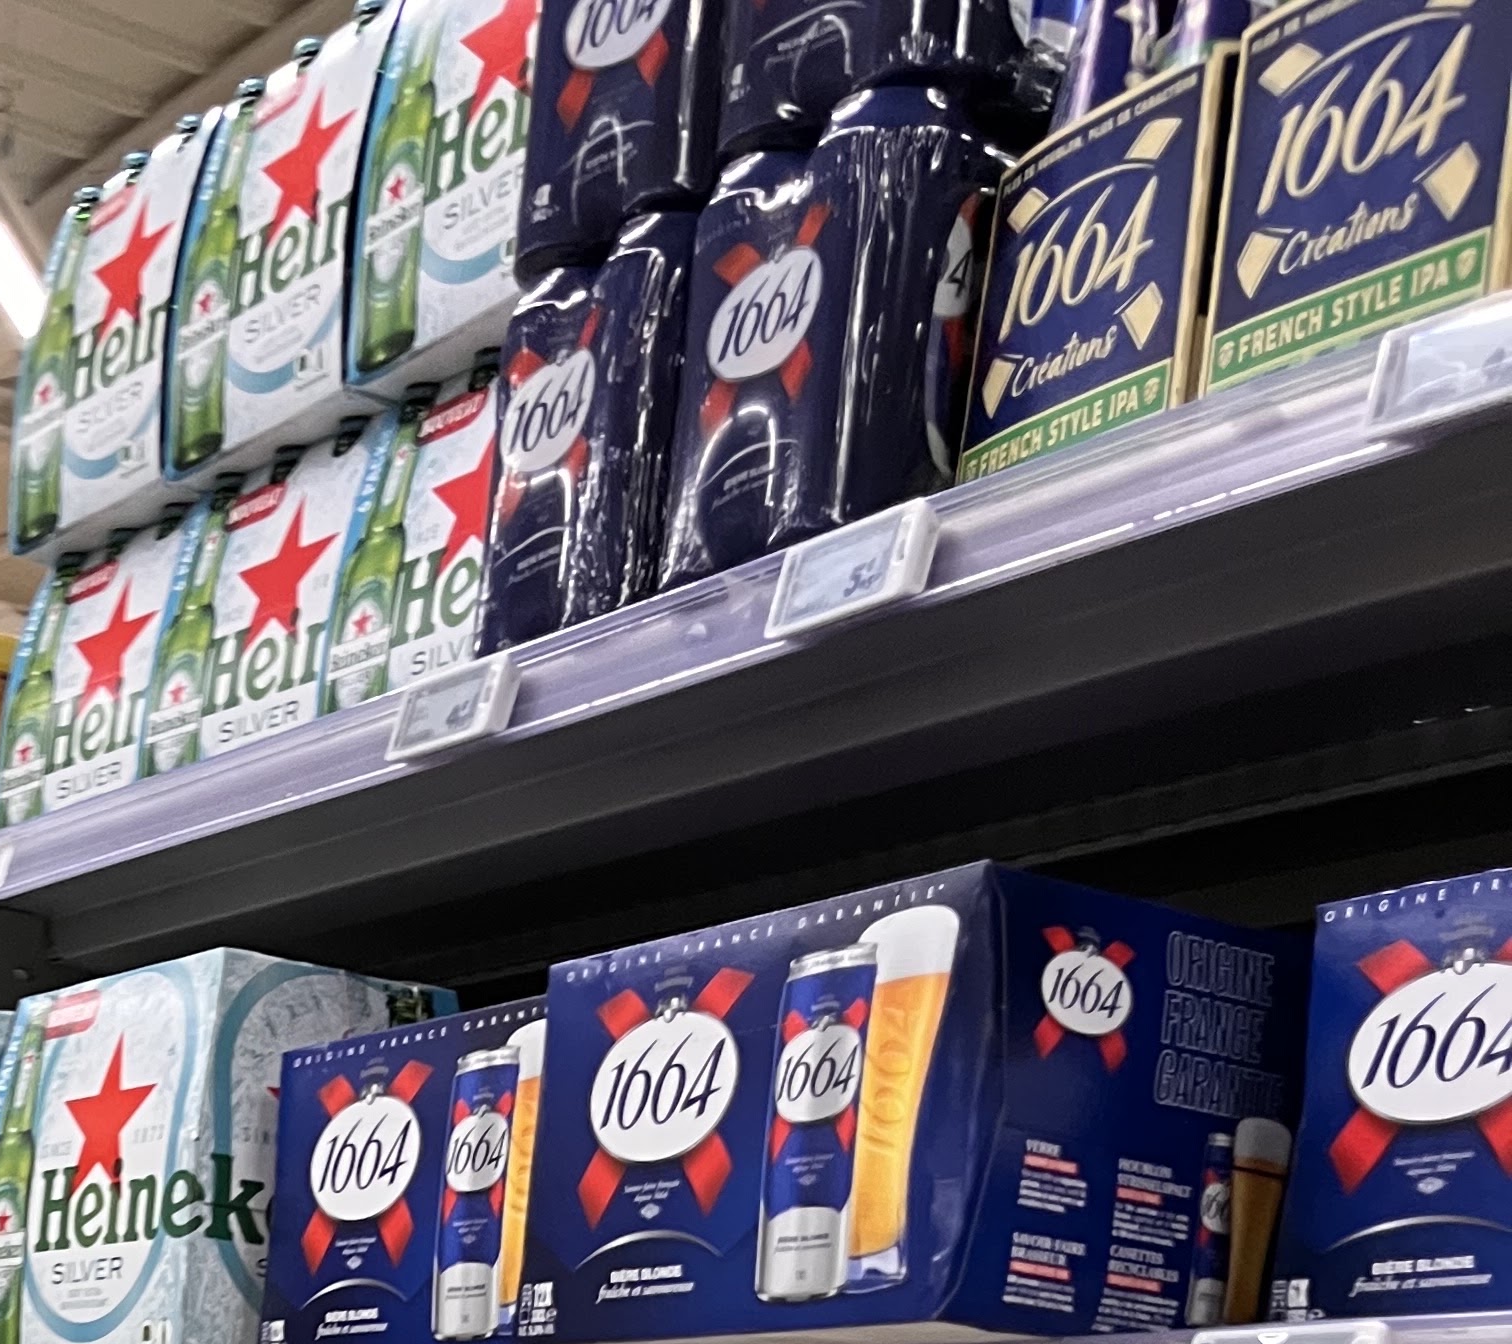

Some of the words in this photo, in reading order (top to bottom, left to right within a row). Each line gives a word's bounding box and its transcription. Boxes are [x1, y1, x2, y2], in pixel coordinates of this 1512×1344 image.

[1258, 23, 1473, 216] 1664
[998, 175, 1159, 345] 1664
[1277, 192, 1421, 277] Créations
[720, 257, 814, 364] 1664
[1237, 312, 1324, 364] FRENCH
[1330, 283, 1402, 329] STYLE
[1411, 257, 1449, 296] IPA
[1011, 325, 1119, 399] Créations
[506, 367, 589, 456] 1664
[979, 429, 1042, 475] FRENCH
[1047, 404, 1102, 448] STYLE
[1108, 391, 1139, 427] IPA
[219, 700, 299, 744] SILVER
[1323, 888, 1448, 923] ORIGINE
[567, 951, 661, 982] ORIGINE
[1048, 964, 1124, 1018] 1664
[1166, 931, 1277, 1007] ORIGINE
[1161, 989, 1269, 1062] FRANCE
[601, 1030, 720, 1132] 1664
[779, 1038, 856, 1103] 1664
[318, 1120, 410, 1194] 1664
[446, 1125, 504, 1176] 1664
[35, 1152, 268, 1253] Heinek
[52, 1256, 123, 1286] SILVER
